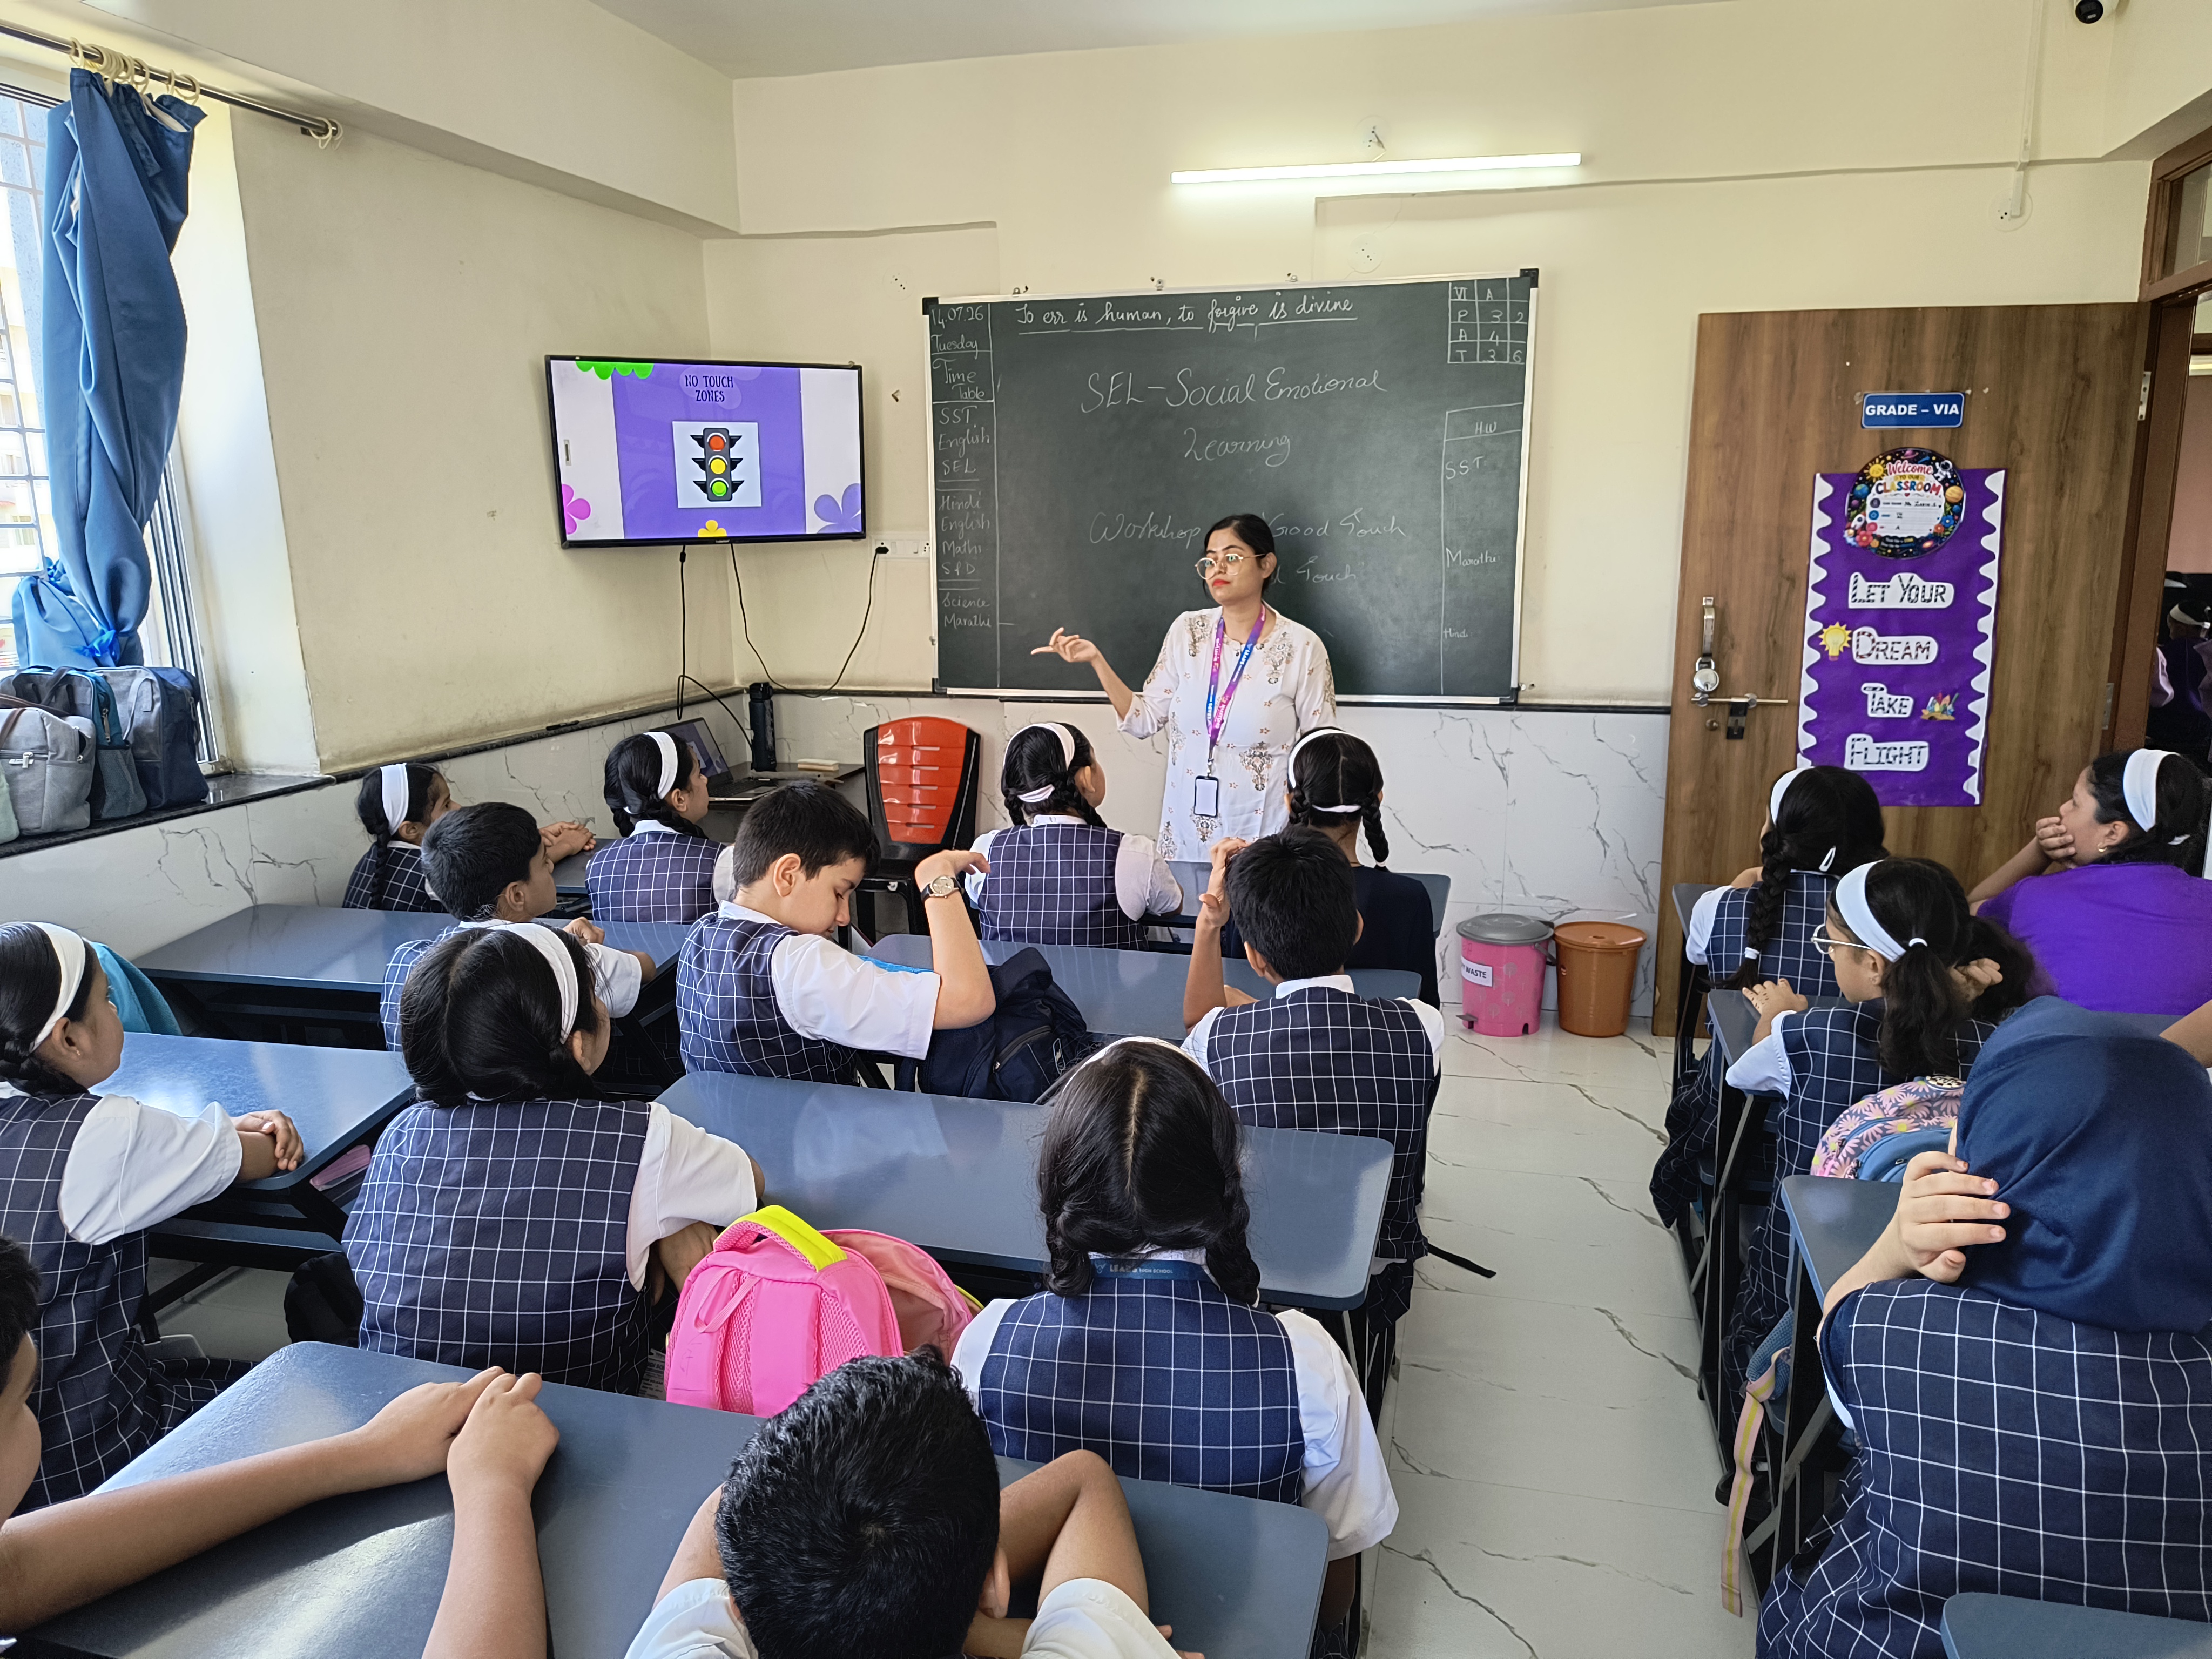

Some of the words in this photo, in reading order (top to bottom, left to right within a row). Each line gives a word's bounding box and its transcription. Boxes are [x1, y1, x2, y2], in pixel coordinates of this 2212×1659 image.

[1486, 288, 1494, 301] A
[932, 305, 984, 329] 14.07.26
[1015, 302, 1034, 324] To
[1043, 311, 1068, 325] err
[1074, 302, 1088, 323] is
[1178, 304, 1195, 322] to
[1208, 295, 1258, 333] forgive
[1269, 291, 1287, 319] is
[1296, 291, 1353, 315] divine
[1458, 309, 1468, 323] P
[1459, 328, 1468, 341] A
[1489, 331, 1499, 346] 4
[931, 334, 979, 360] Tuesday
[1455, 350, 1467, 363] T
[1513, 350, 1522, 363] 6
[933, 358, 977, 384] Time
[685, 375, 698, 387] NO
[703, 375, 733, 388] TOUCH
[1264, 367, 1388, 400] Emotional
[696, 390, 725, 402] ZONES
[952, 383, 985, 401] Table
[940, 405, 977, 425] SST
[1865, 404, 1918, 416] GRADE
[1933, 404, 1959, 415] VIA
[938, 424, 990, 458] English
[1184, 428, 1291, 467] Learning
[942, 458, 976, 475] SEL
[1887, 460, 1933, 475] Welcome
[1876, 481, 1941, 496] CLASSROOM
[938, 491, 981, 511] Hindi
[941, 511, 990, 540] English
[1090, 512, 1201, 549] Workshop
[1339, 507, 1406, 537] Touch
[942, 539, 982, 558] Maths
[1851, 574, 1890, 604] LET
[1898, 574, 1946, 603] YOUR
[942, 591, 990, 608] Science
[944, 613, 992, 630] Marathi
[1856, 631, 1931, 660] DREAM
[1863, 686, 1910, 715] TAKE
[1850, 737, 1928, 765] FLIGHT
[1465, 966, 1487, 979] WASTE
